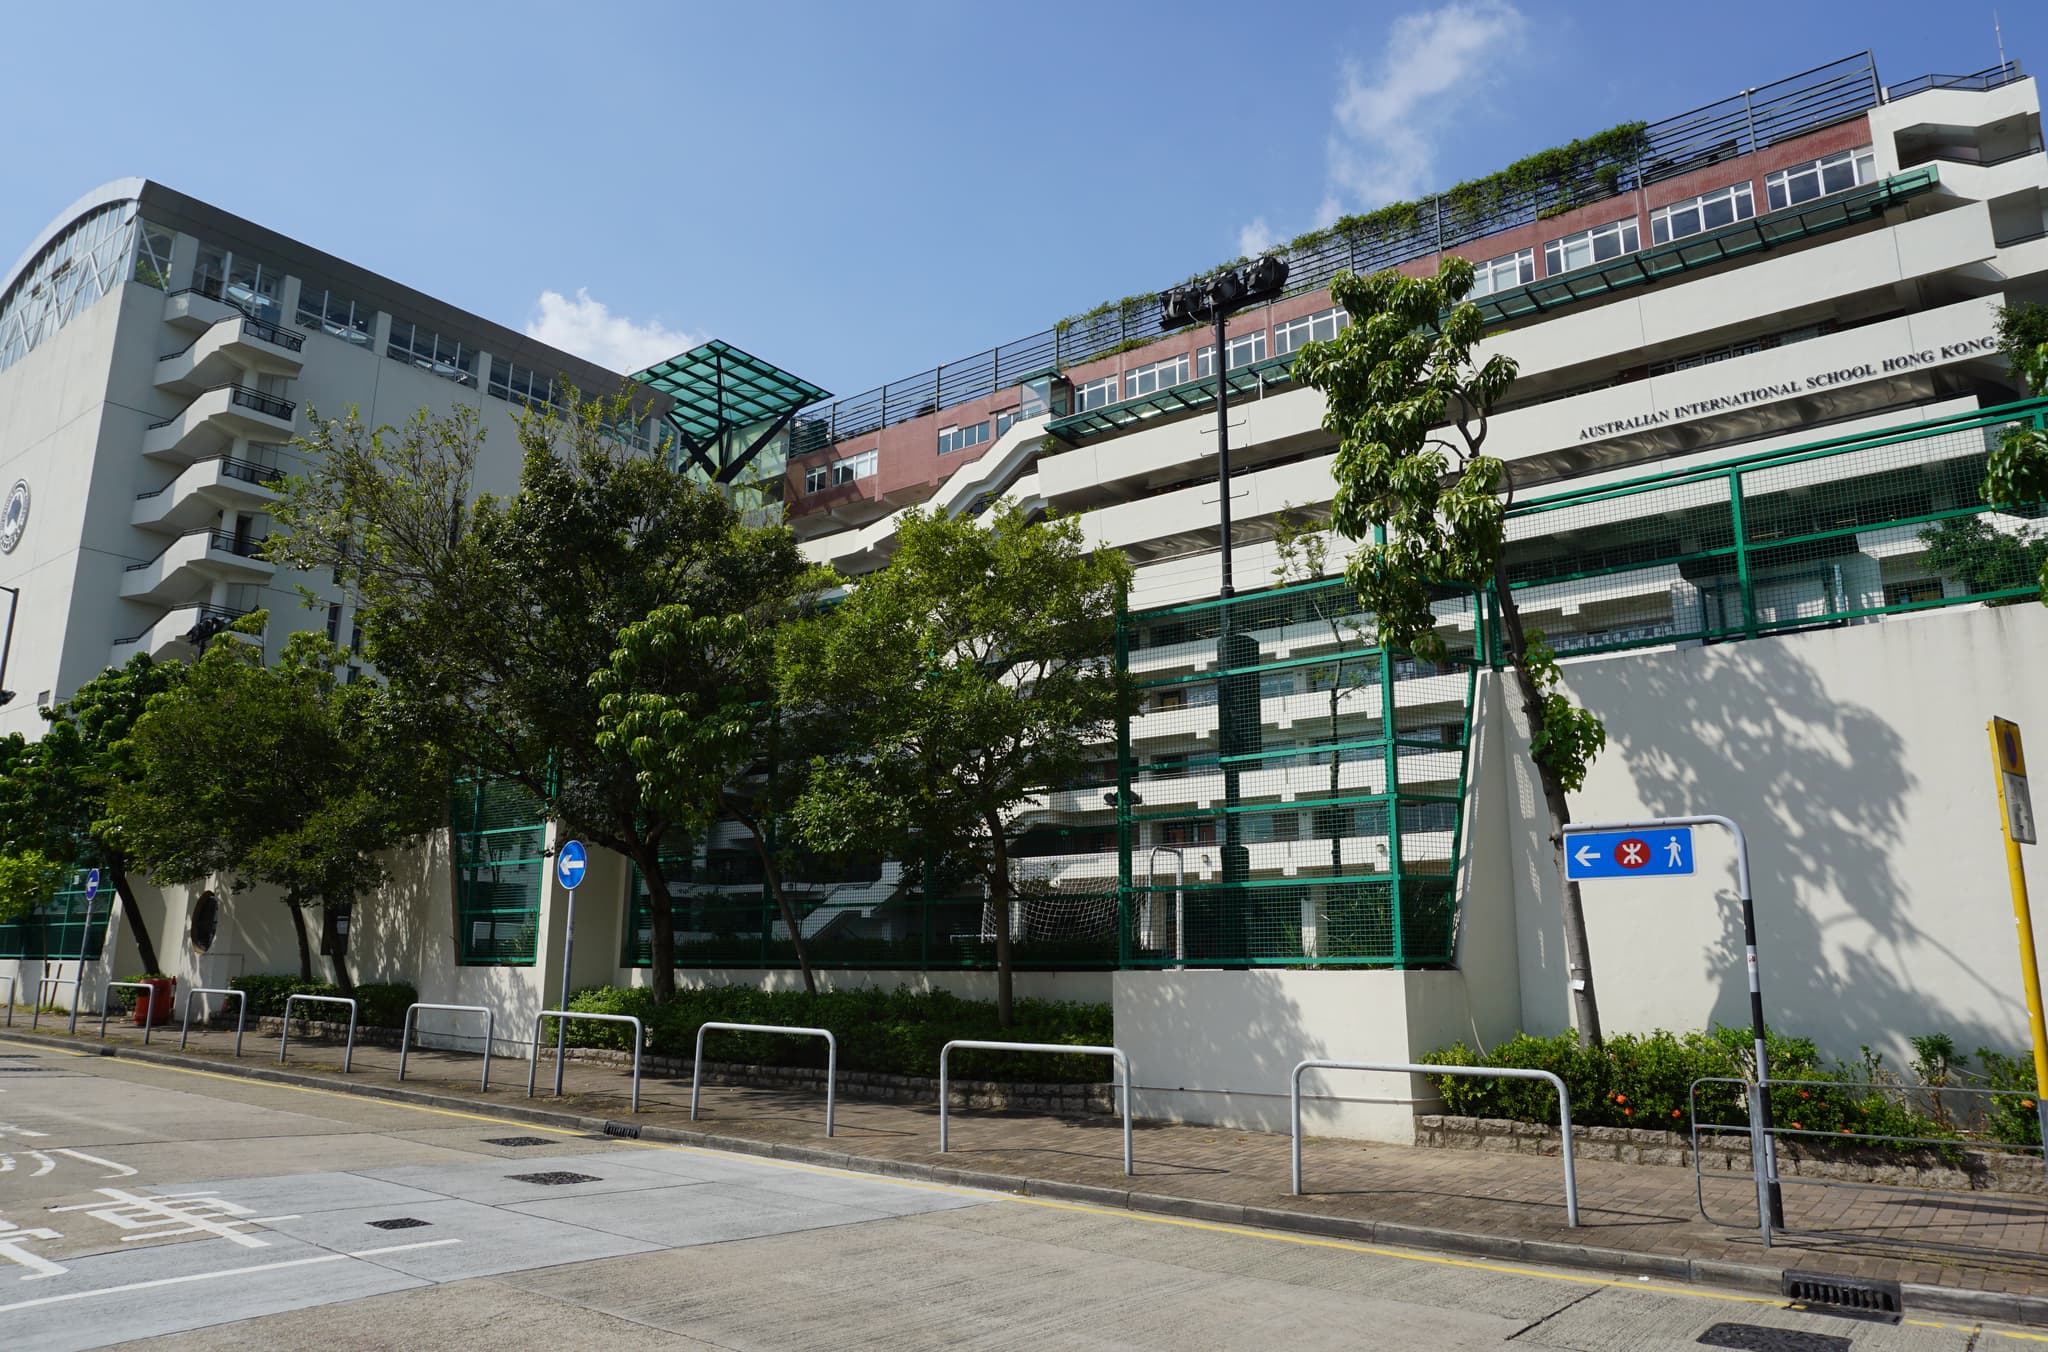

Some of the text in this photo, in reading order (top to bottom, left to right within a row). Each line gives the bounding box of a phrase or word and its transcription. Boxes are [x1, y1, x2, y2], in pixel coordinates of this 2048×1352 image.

[1579, 336, 1996, 440] AUSTRALIAN INTERNATIONAL SCHOOL HONG KONG
